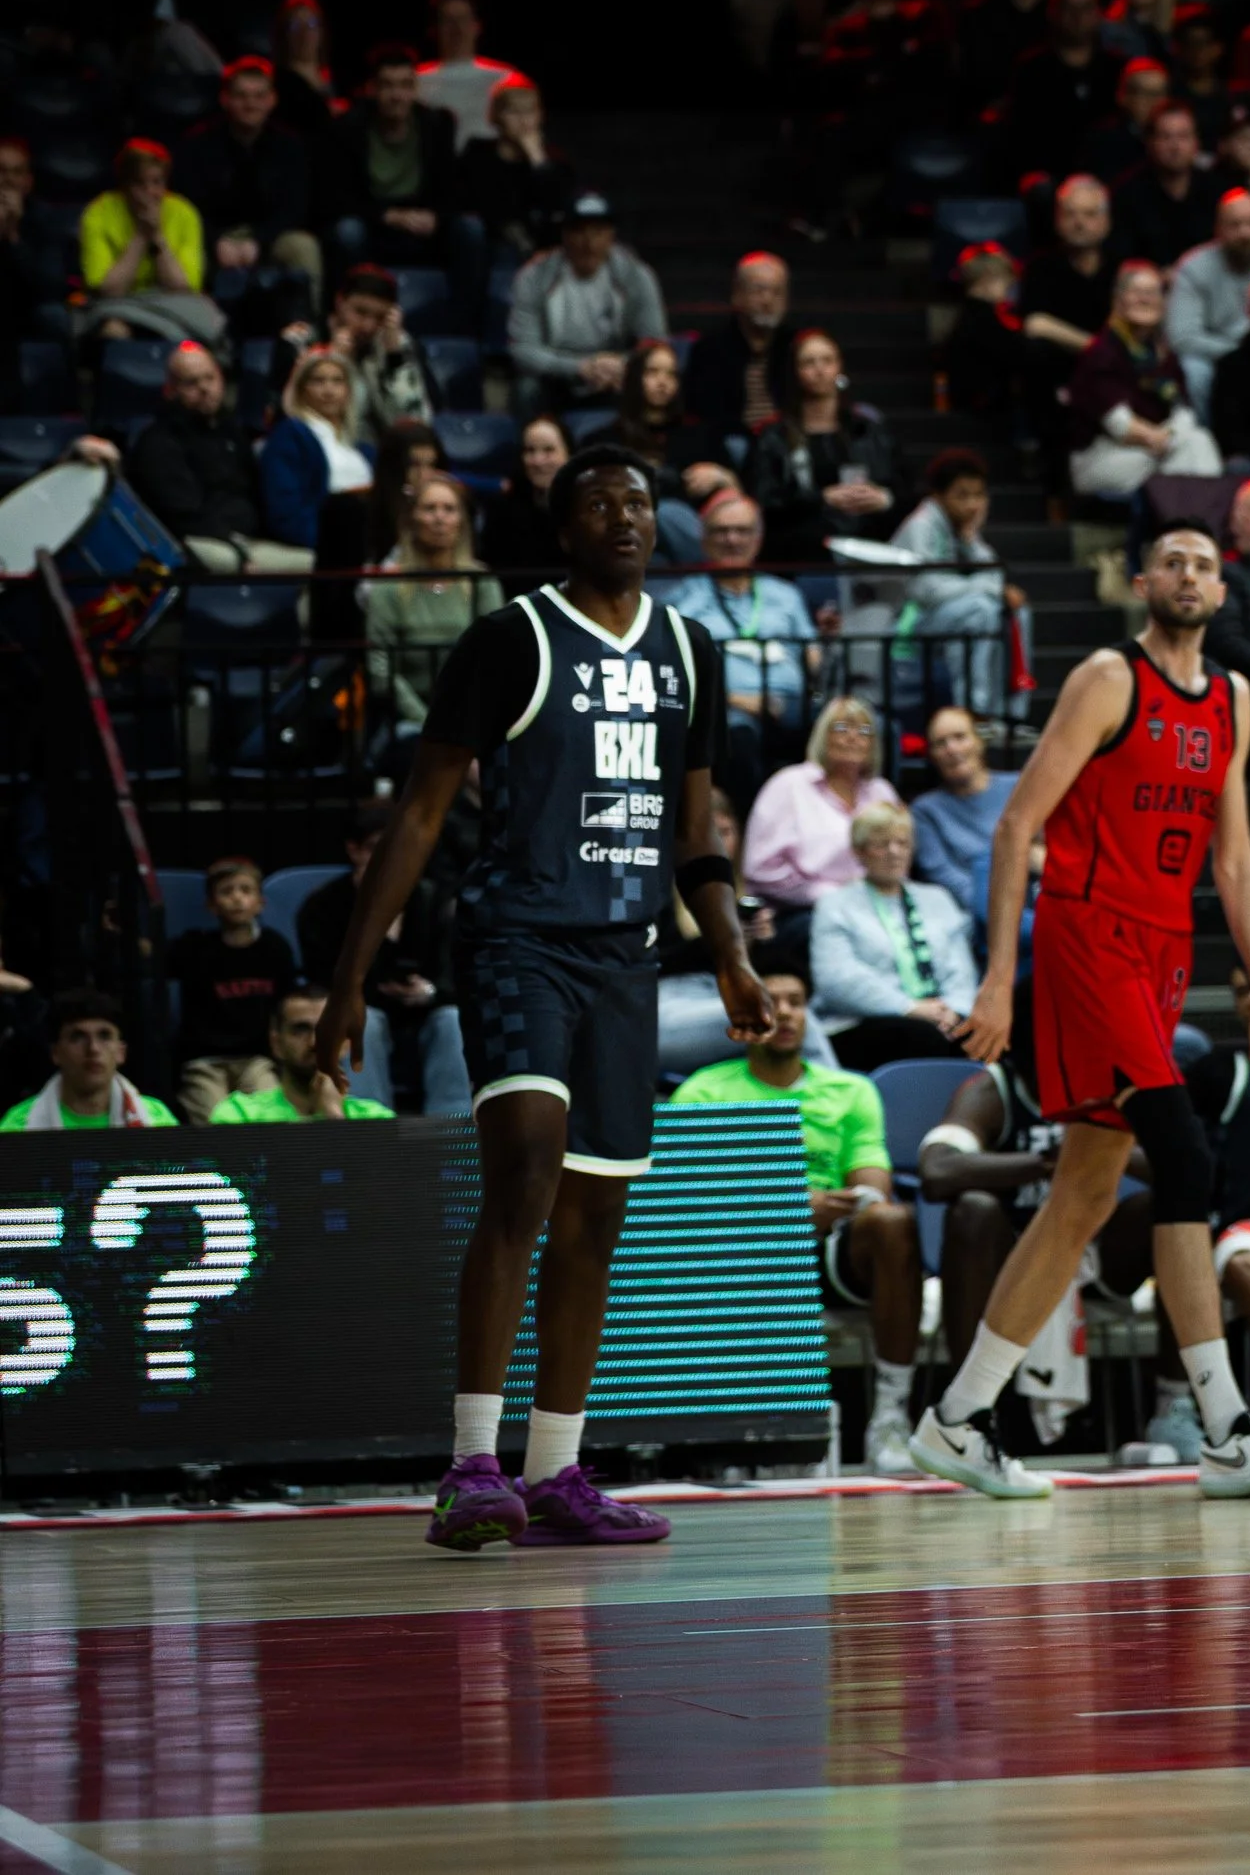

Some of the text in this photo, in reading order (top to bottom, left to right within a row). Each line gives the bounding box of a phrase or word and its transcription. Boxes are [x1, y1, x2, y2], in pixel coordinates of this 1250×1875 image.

[599, 658, 659, 713] 24
[594, 720, 662, 781] BXL
[1173, 721, 1212, 774] 13
